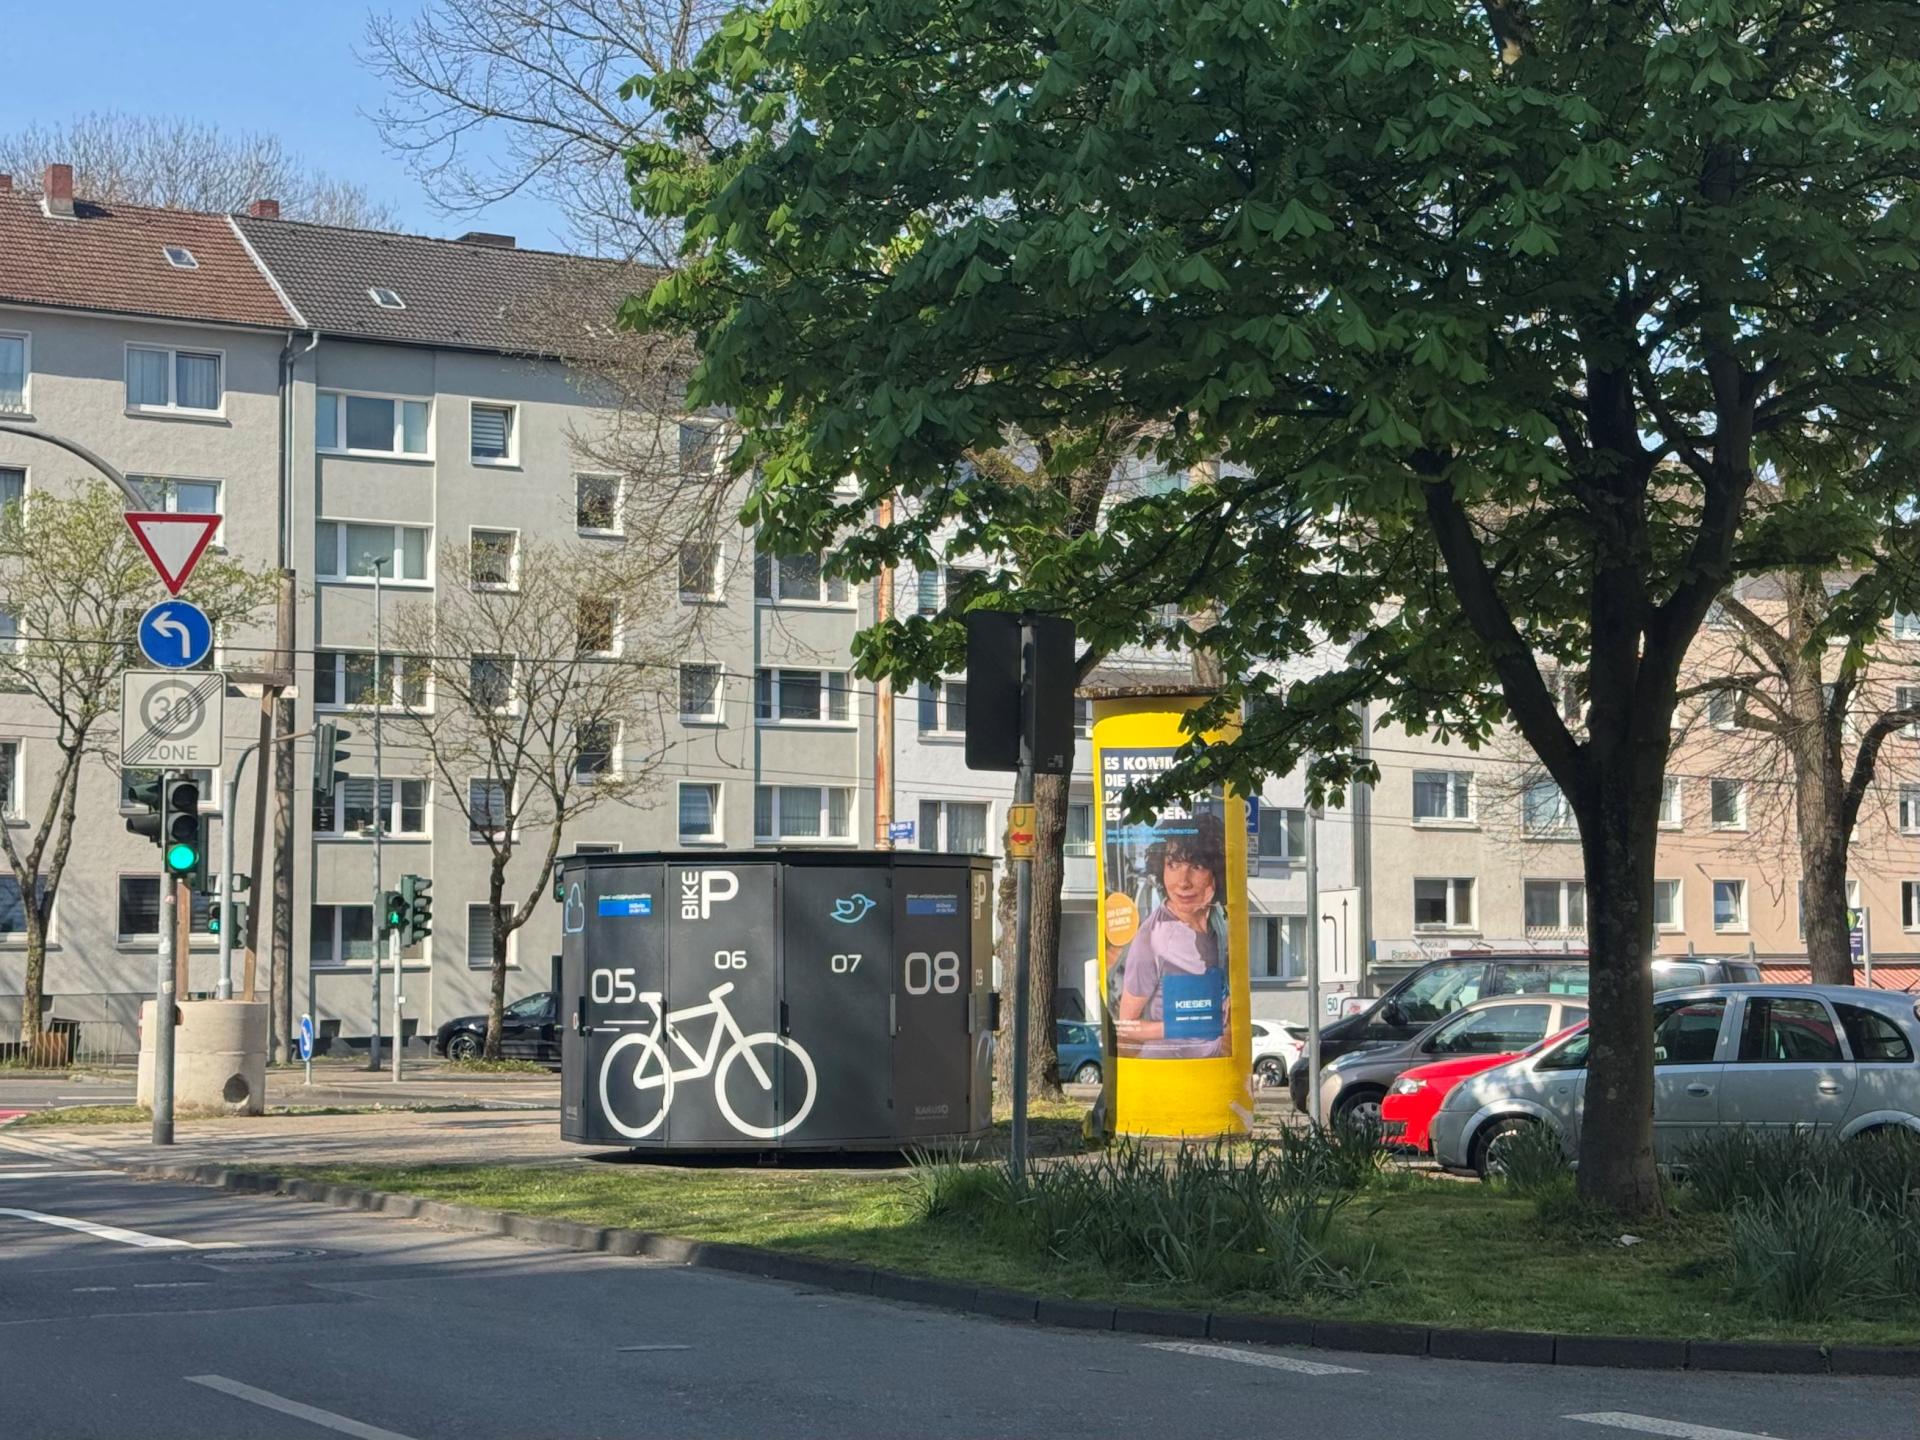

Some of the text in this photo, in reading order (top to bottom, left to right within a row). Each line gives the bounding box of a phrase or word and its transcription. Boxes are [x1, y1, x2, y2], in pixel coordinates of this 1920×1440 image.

[154, 696, 191, 724] 30
[147, 745, 198, 761] ZONE
[1103, 756, 1120, 771] ES
[1104, 773, 1127, 788] DIE
[1105, 806, 1121, 821] ES
[682, 870, 739, 919] BIKE P
[714, 950, 748, 970] 06
[831, 954, 862, 973] 07
[905, 951, 960, 995] 08
[591, 967, 637, 1004] 05
[1175, 999, 1212, 1009] KIESER
[1327, 997, 1338, 1012] 50
